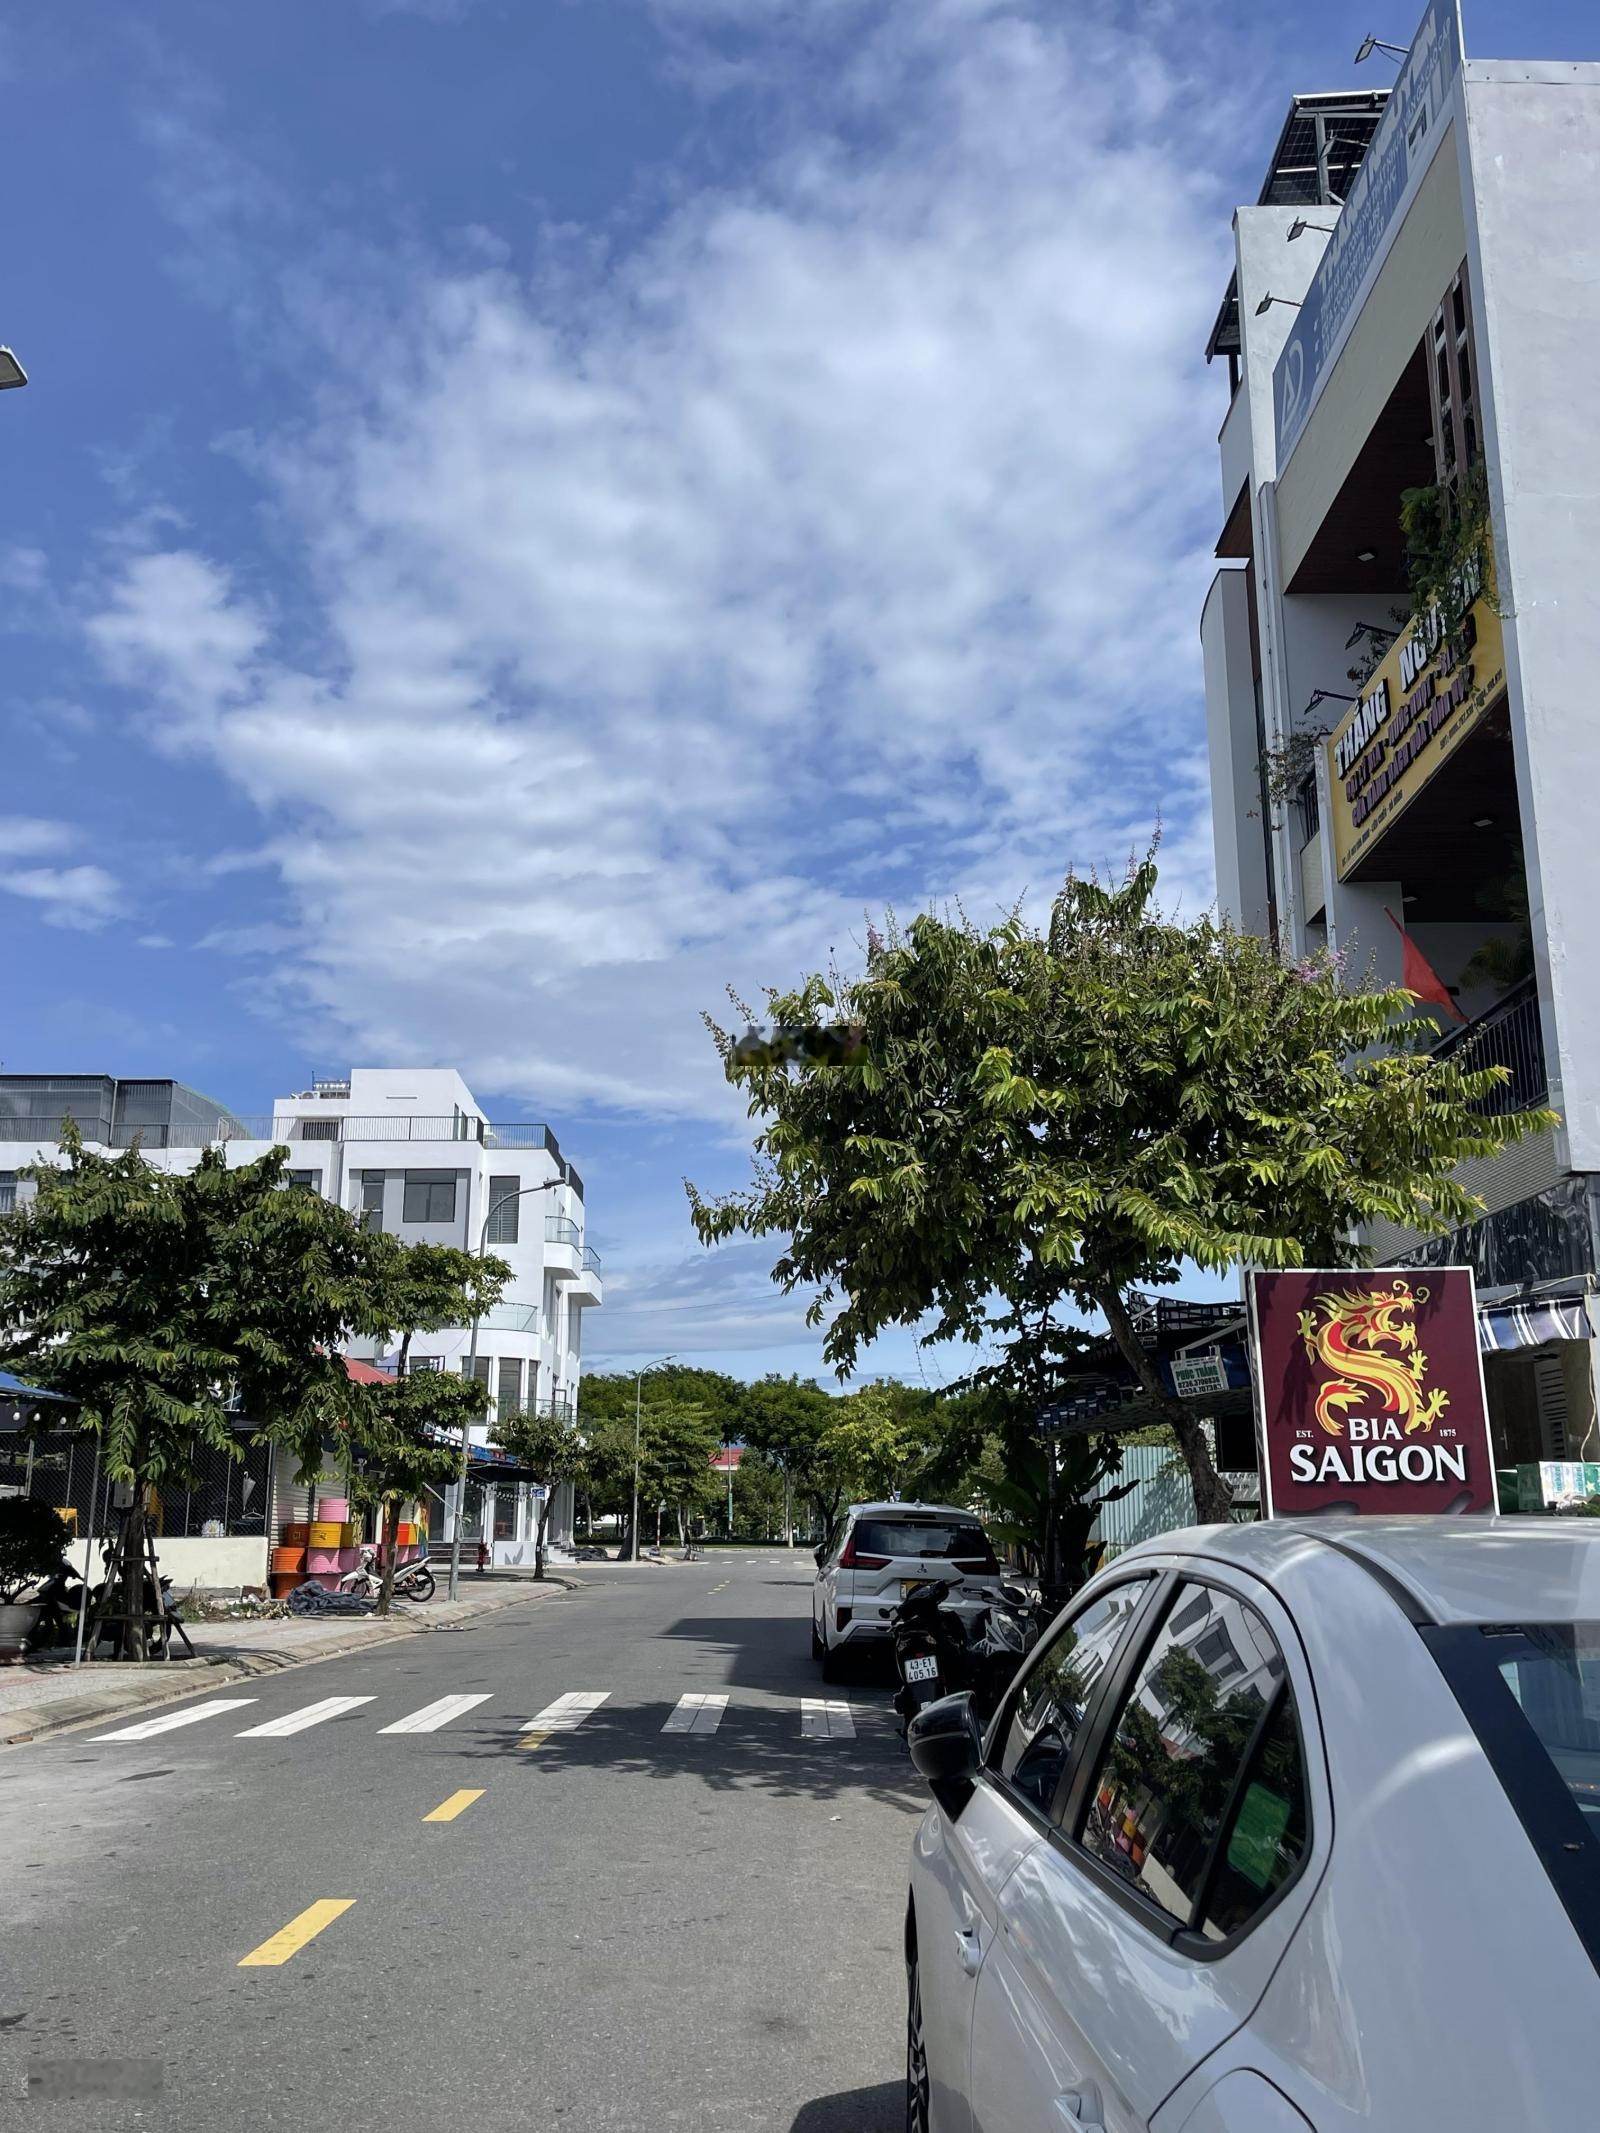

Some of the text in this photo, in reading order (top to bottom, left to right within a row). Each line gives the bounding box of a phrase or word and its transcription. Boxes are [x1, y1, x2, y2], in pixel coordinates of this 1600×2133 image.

[1295, 1430, 1314, 1438] EST.
[1348, 1418, 1404, 1441] BIA
[1439, 1429, 1457, 1437] 1875
[1289, 1444, 1467, 1483] SAIGON
